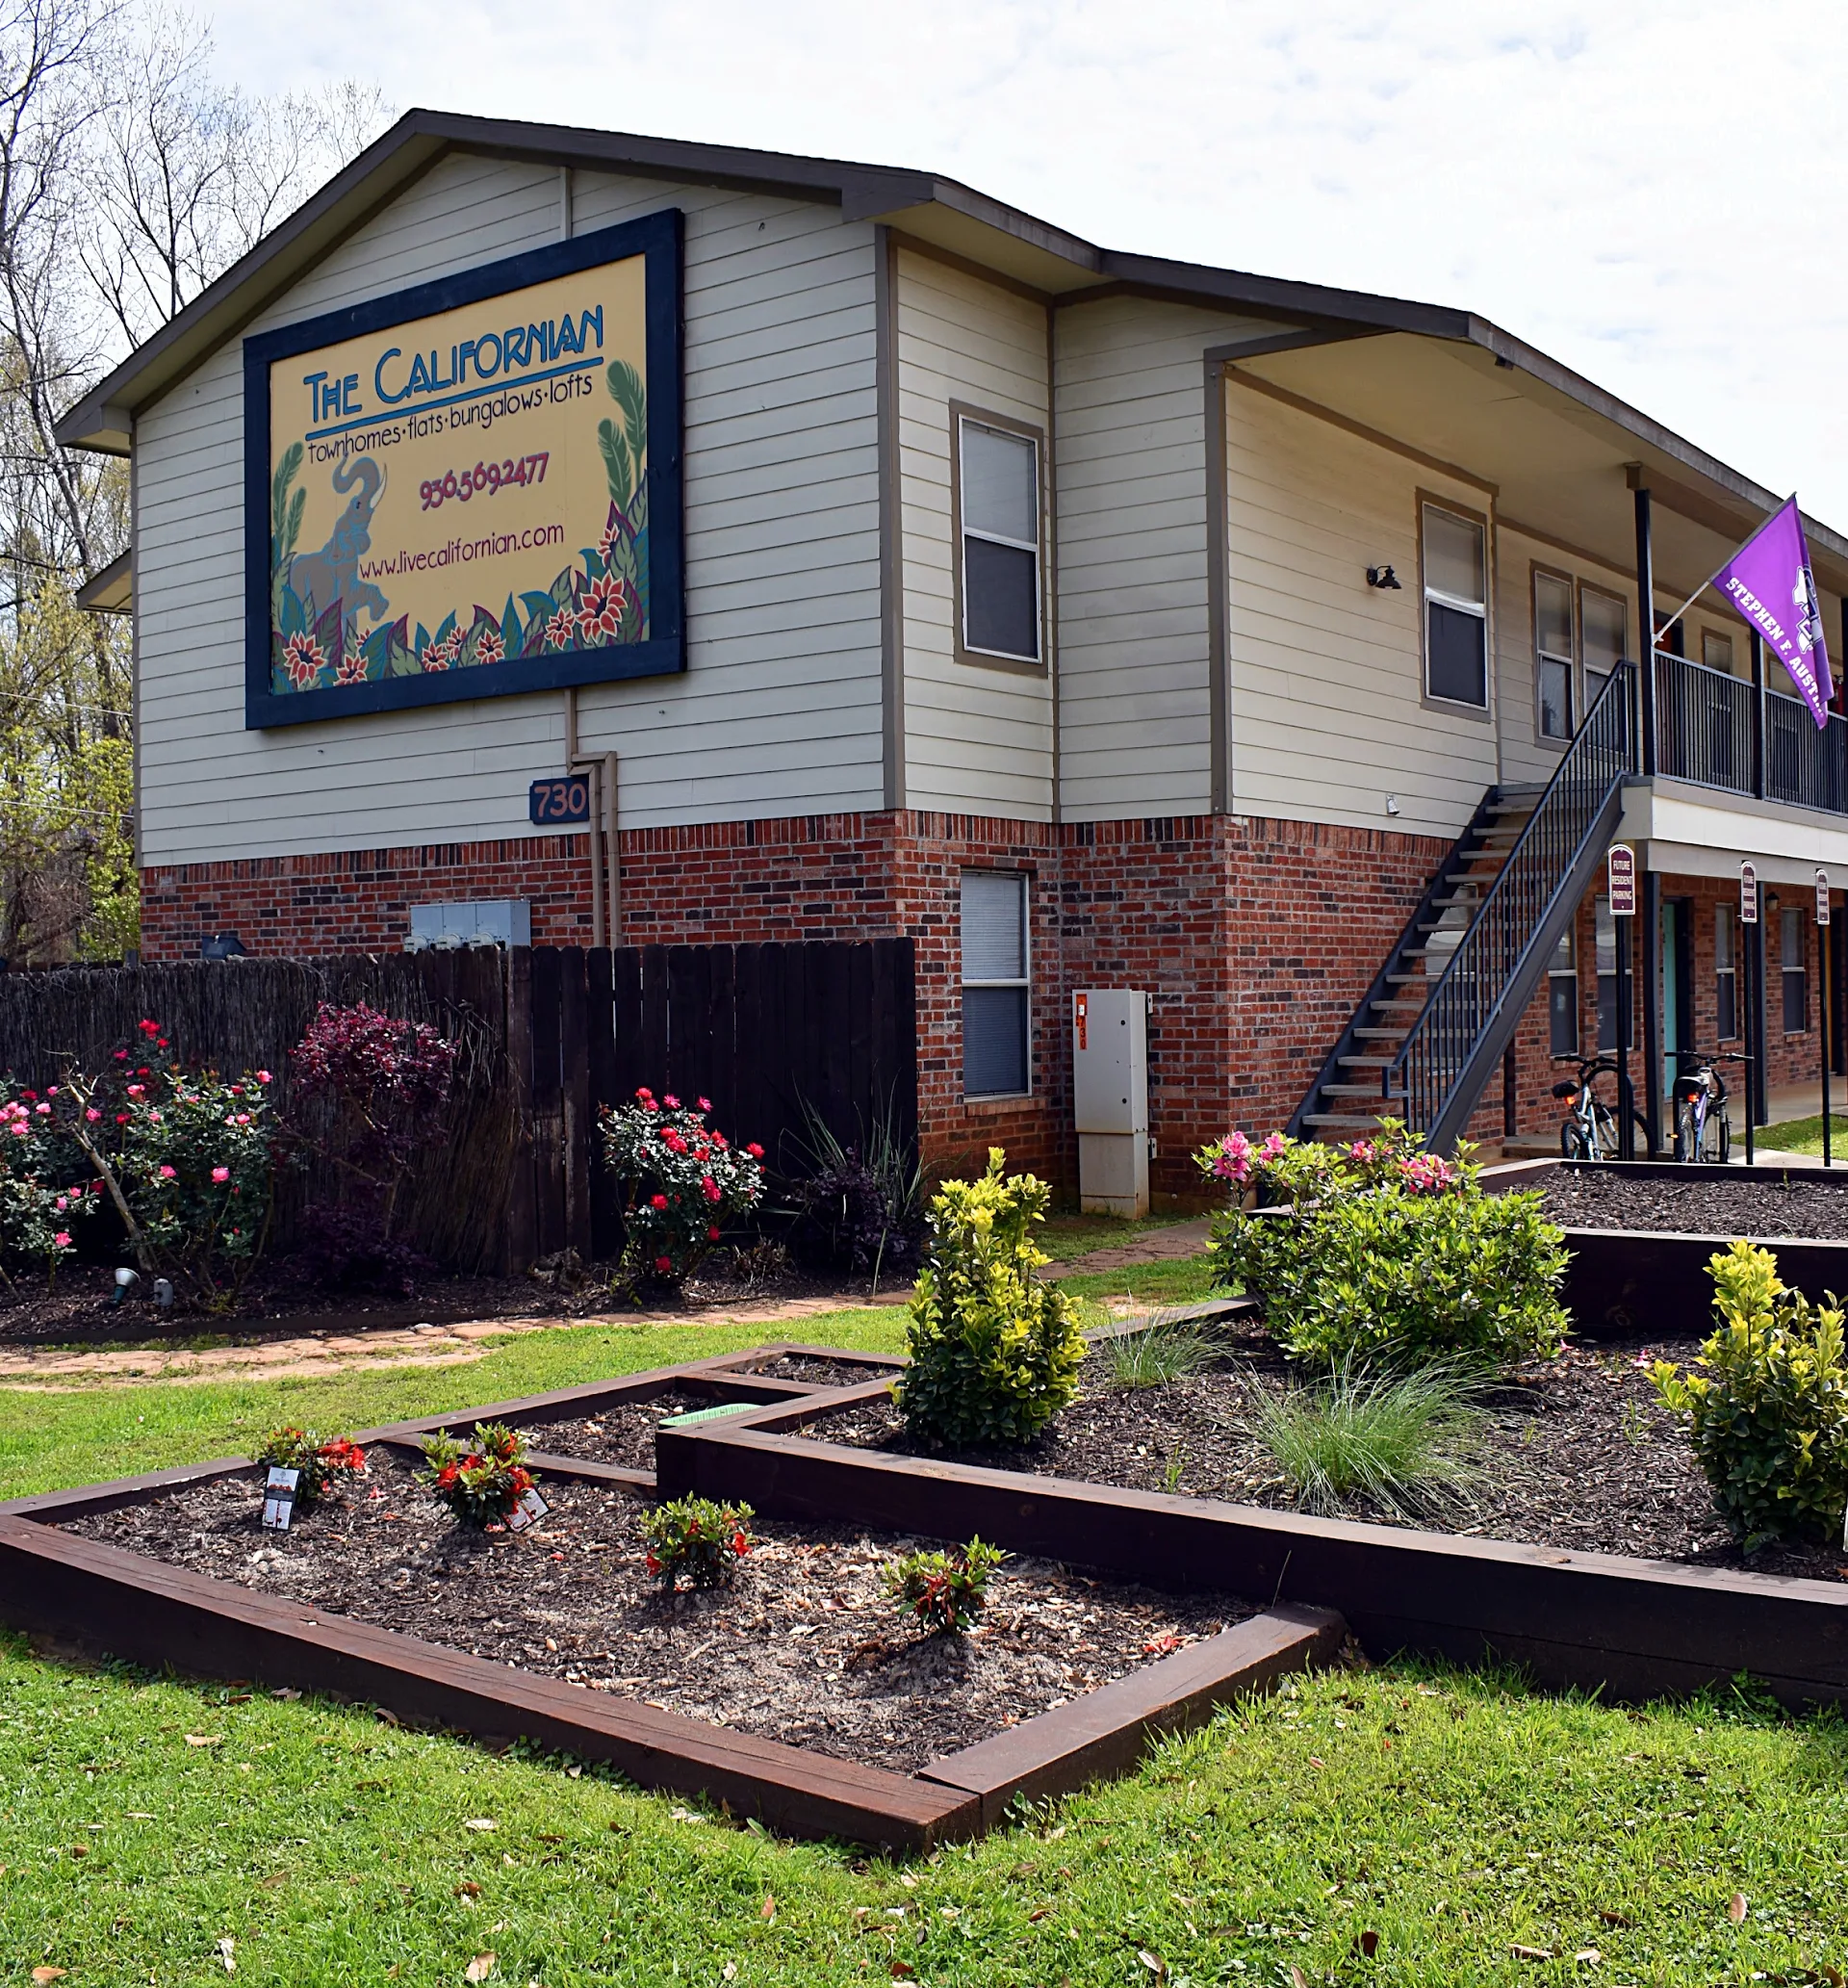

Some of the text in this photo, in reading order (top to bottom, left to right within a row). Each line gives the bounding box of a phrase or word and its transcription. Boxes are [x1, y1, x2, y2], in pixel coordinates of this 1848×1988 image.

[303, 304, 603, 424] THE CALIFORNIAN
[420, 452, 550, 511] 936.569.2477
[359, 525, 564, 579] www.livecalifornian.com
[1725, 577, 1822, 713] STEPHEN F. AUST
[534, 783, 586, 817] 730
[1611, 875, 1632, 885] RESIDENT
[1612, 860, 1630, 870] FUTURE
[1612, 890, 1631, 900] PARKING
